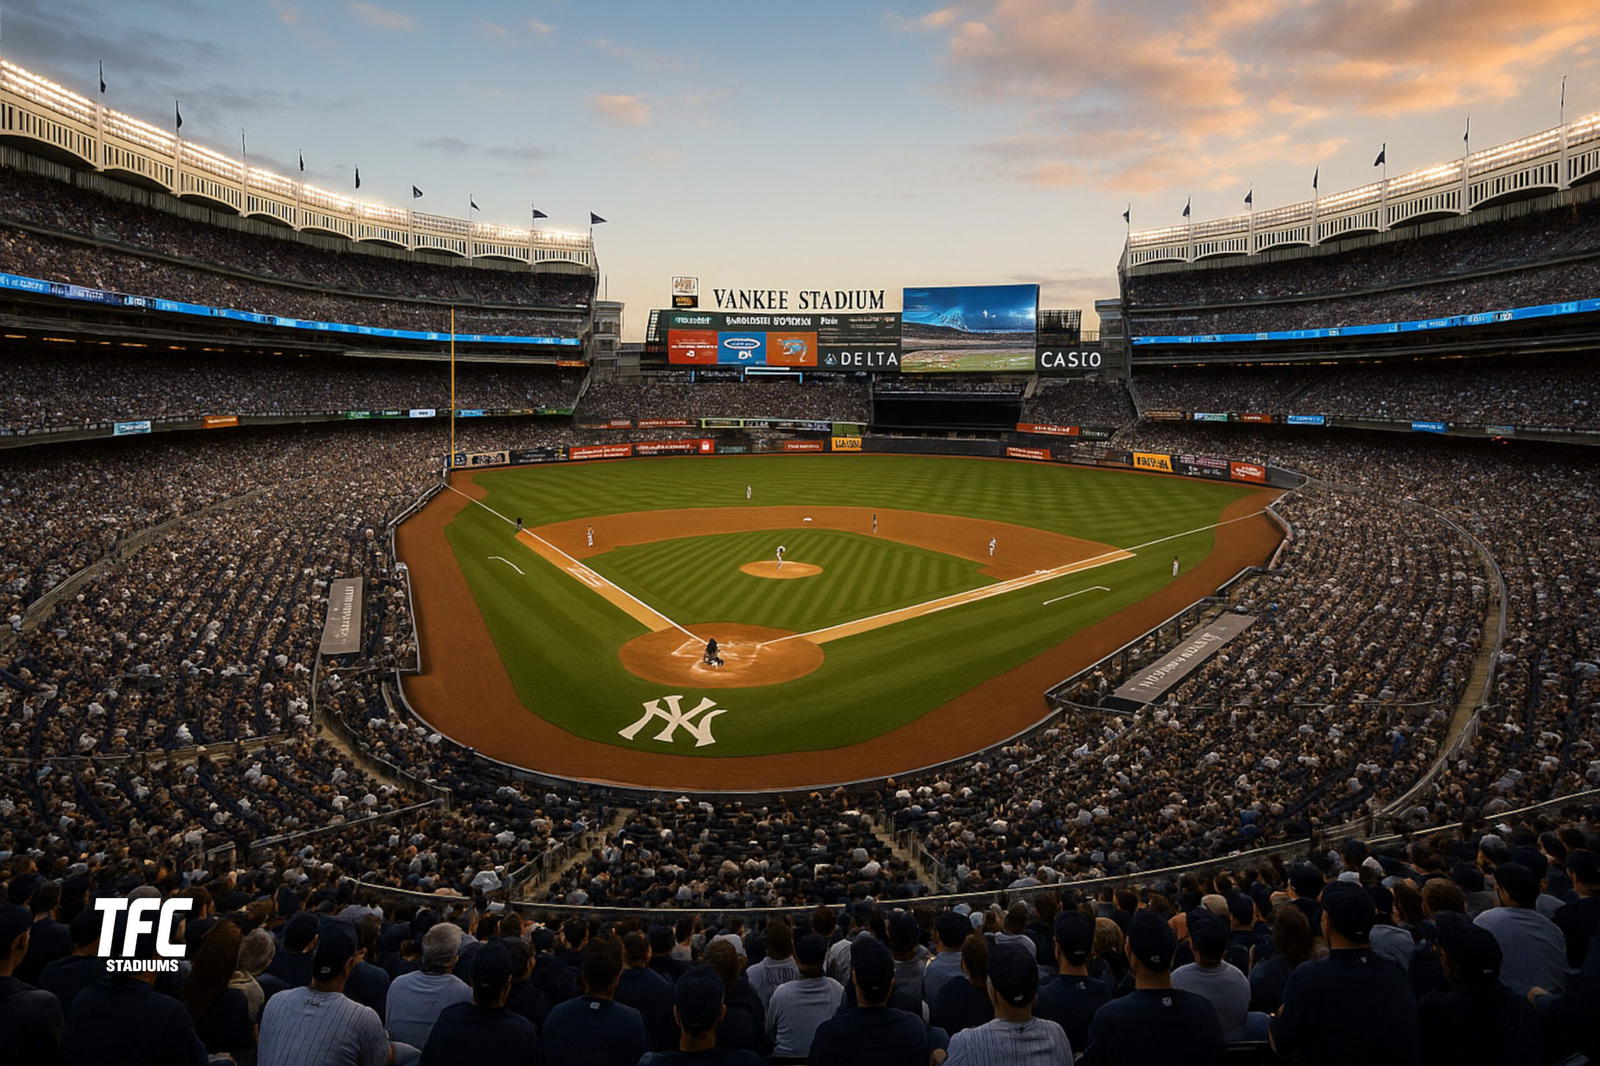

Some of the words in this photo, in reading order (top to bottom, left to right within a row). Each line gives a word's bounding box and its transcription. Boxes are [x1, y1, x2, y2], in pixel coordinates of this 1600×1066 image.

[799, 289, 885, 310] STADIUM
[841, 352, 898, 366] DELTA
[1041, 352, 1102, 368] CASIO
